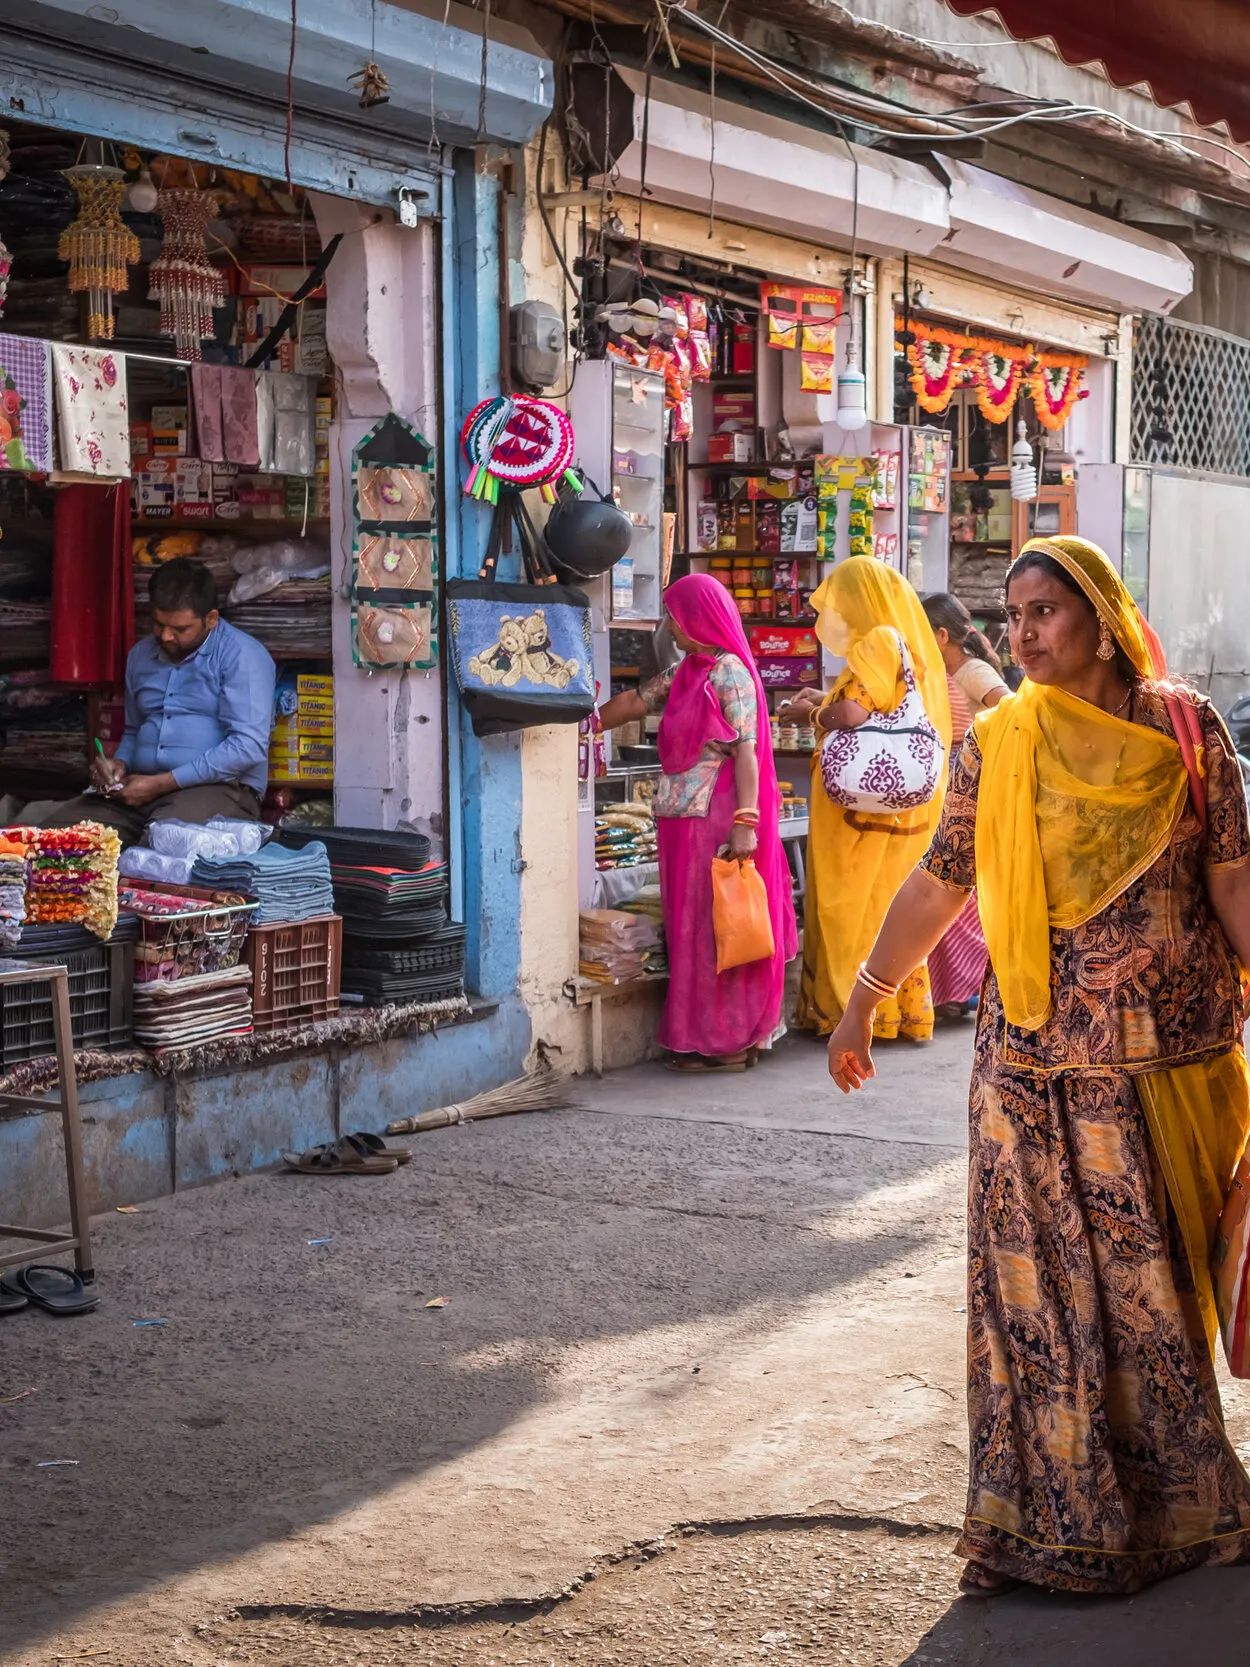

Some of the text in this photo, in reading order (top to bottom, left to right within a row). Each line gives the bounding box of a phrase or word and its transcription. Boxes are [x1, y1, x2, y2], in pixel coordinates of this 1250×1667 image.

[146, 507, 172, 516] MAYER
[300, 681, 326, 689] TITANIC
[300, 701, 326, 710] TITANIC
[301, 719, 326, 728] TITANIC
[303, 766, 328, 775] TITANIC
